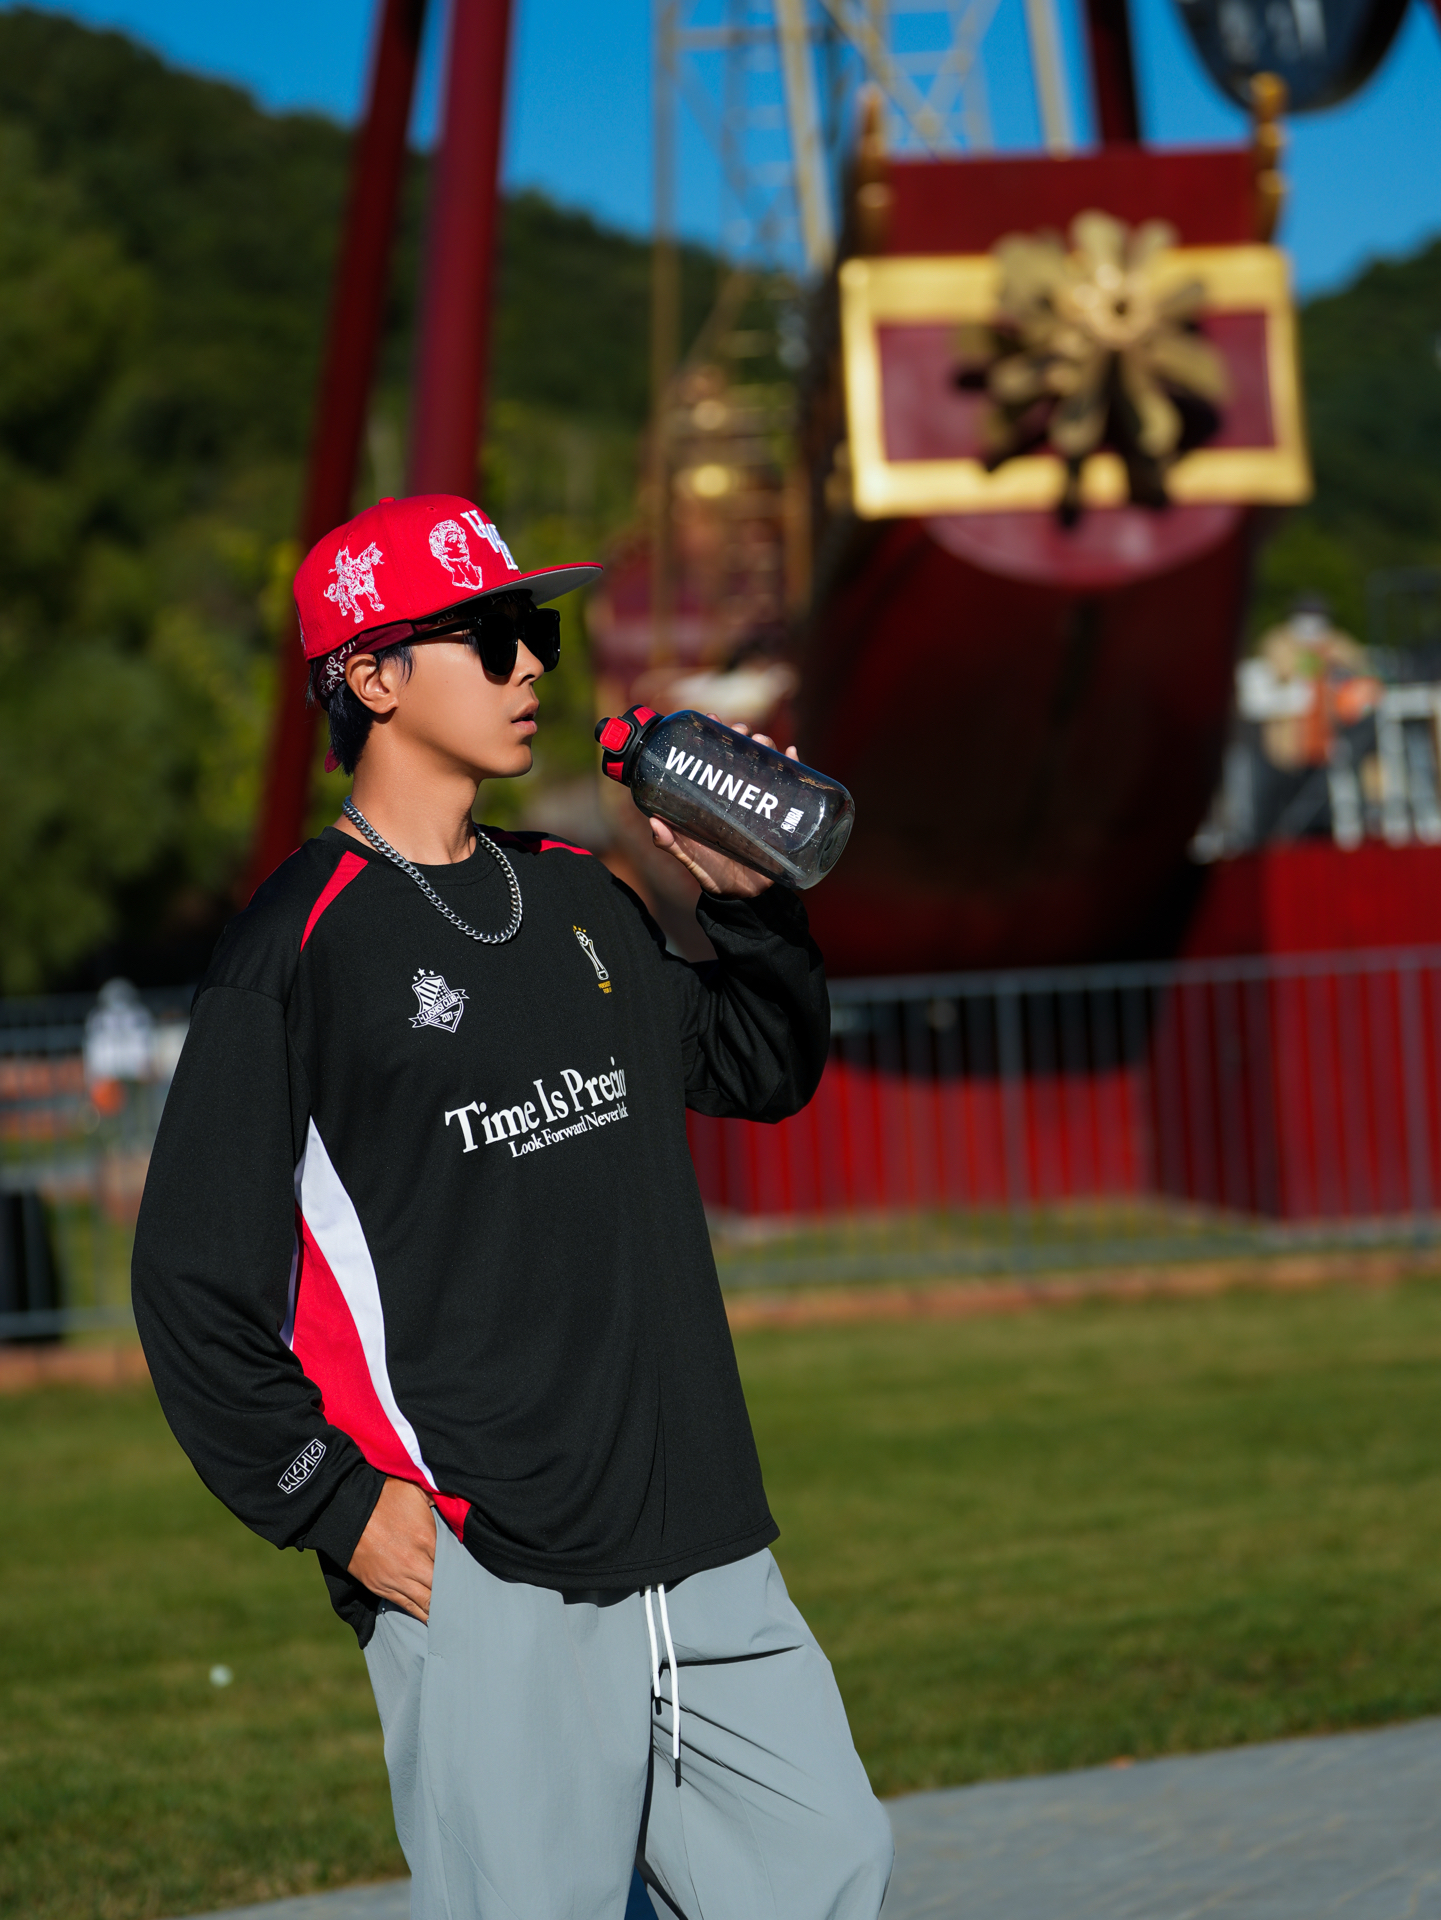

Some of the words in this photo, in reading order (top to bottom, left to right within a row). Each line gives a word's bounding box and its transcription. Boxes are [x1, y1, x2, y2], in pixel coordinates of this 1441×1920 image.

[665, 746, 779, 820] WINNER
[444, 1100, 541, 1154] Time
[532, 1078, 570, 1123] Is
[508, 1133, 546, 1158] Look
[540, 1115, 588, 1146] Forward
[584, 1111, 620, 1131] Never
